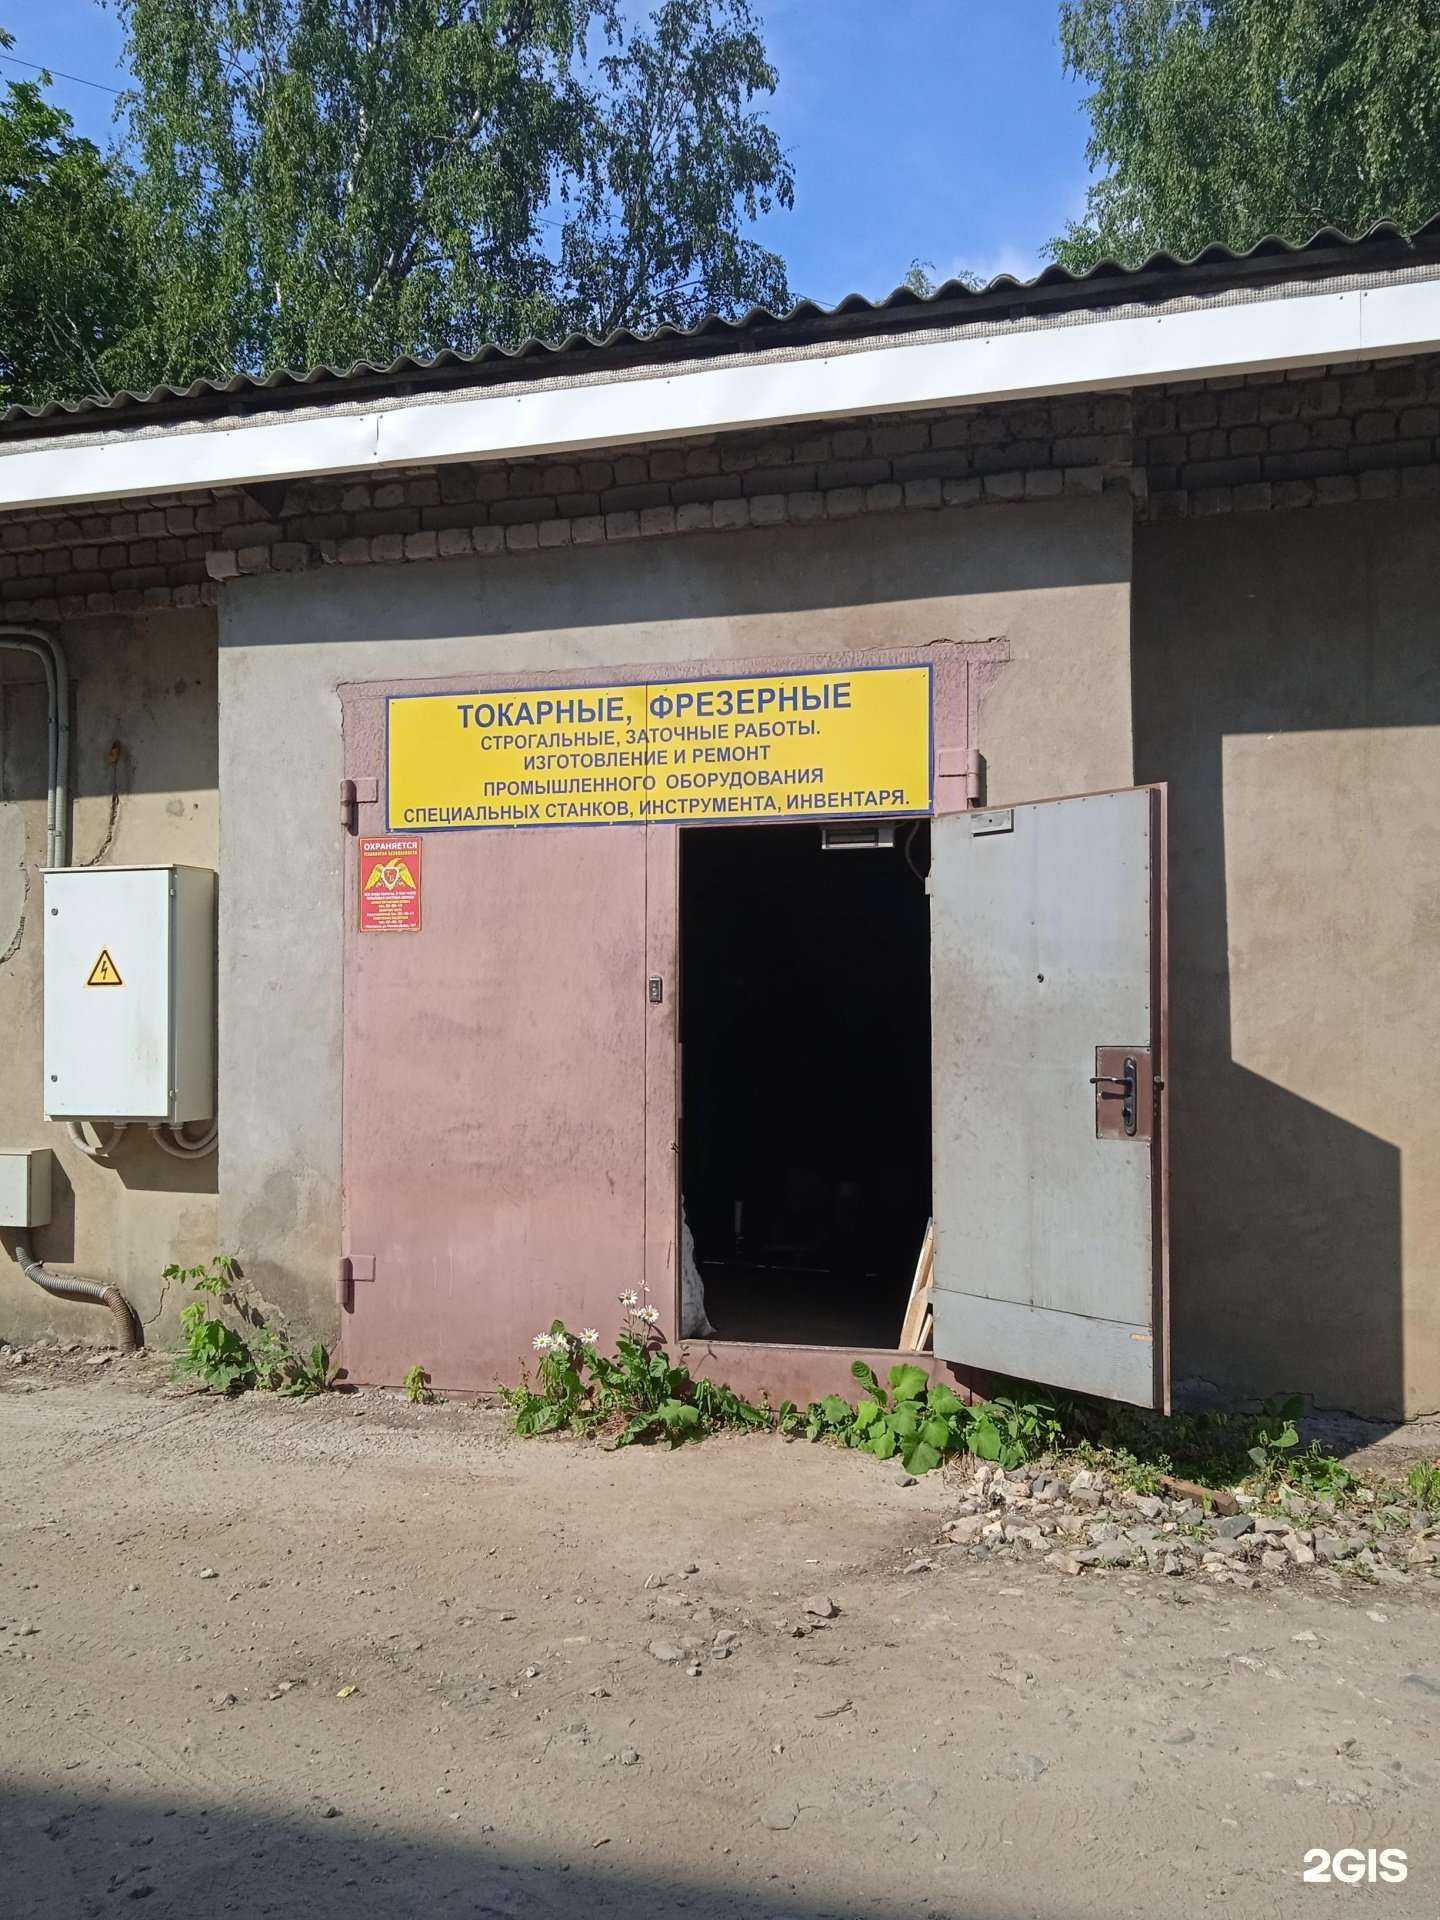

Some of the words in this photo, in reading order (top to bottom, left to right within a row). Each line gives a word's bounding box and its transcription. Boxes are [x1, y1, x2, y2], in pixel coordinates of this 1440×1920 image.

[457, 697, 632, 728] ТОКАРНЫЕ,
[649, 682, 851, 719] ФРЕЗЕРНЫЕ
[481, 730, 620, 750] СТРОГАЛЬНЫЕ,
[626, 724, 729, 744] ЗАТОЧНЫЕ
[734, 720, 820, 738] РАБОТЫ.
[524, 750, 668, 771] ИЗГОТОВЛЕНИЕ
[674, 749, 686, 764] И
[692, 745, 770, 763] РЕМОНТ
[484, 775, 656, 796] ПРОМЫШЛЕННОГО
[666, 768, 824, 789] ОБОРУДОВАНИЯ
[404, 804, 540, 824] СПЕЦИАЛЬНЫХ
[545, 800, 633, 818] СТАНКОВ,
[639, 795, 781, 815] ИНСТРУМЕНТА,
[787, 789, 909, 809] ИНВЕНТАРЯ.
[363, 841, 418, 851] ОХРАНЯЕТСЯ
